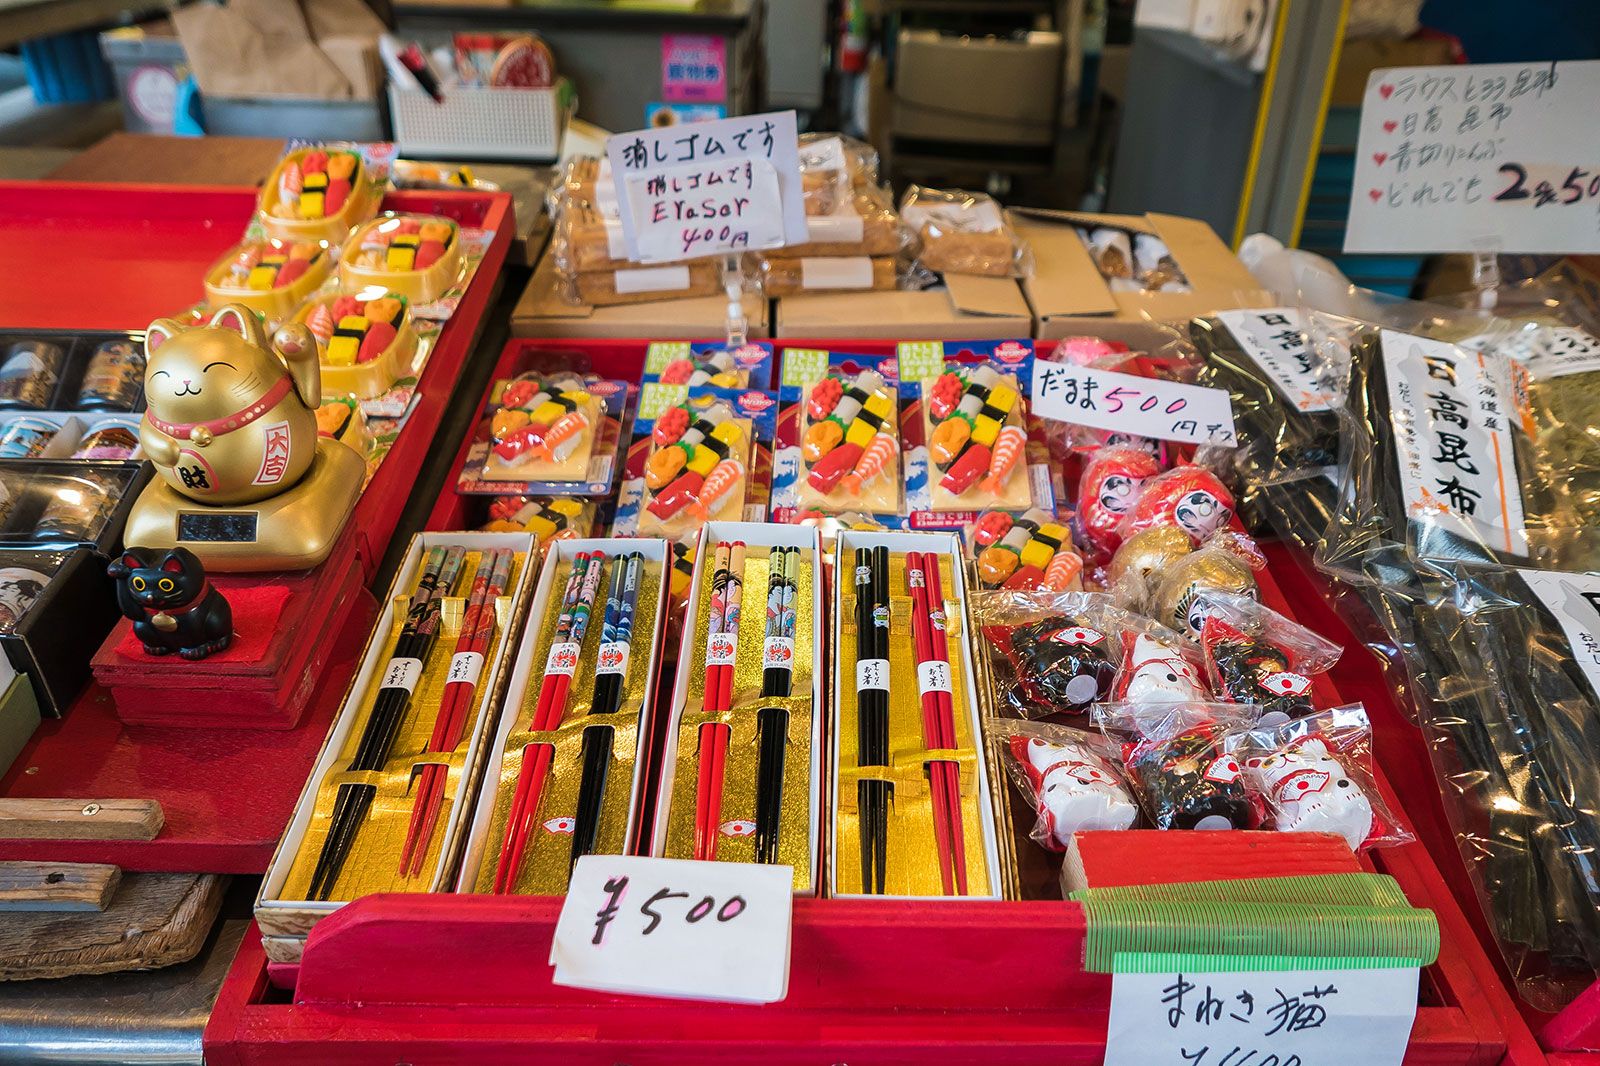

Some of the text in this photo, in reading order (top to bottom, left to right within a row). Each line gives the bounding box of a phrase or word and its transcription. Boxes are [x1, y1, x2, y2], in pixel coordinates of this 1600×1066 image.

[622, 121, 776, 169] 消しゴムです
[647, 160, 753, 197] 消しゴムです
[1388, 174, 1482, 208] どれでも
[266, 431, 288, 477] 大吉
[1423, 355, 1483, 517] 日高昆布
[180, 466, 210, 489] 財
[1264, 675, 1280, 686] MADE
[1287, 674, 1309, 684] JAPAN
[591, 874, 747, 946] ¥500
[1161, 973, 1339, 1037] まねき猫
